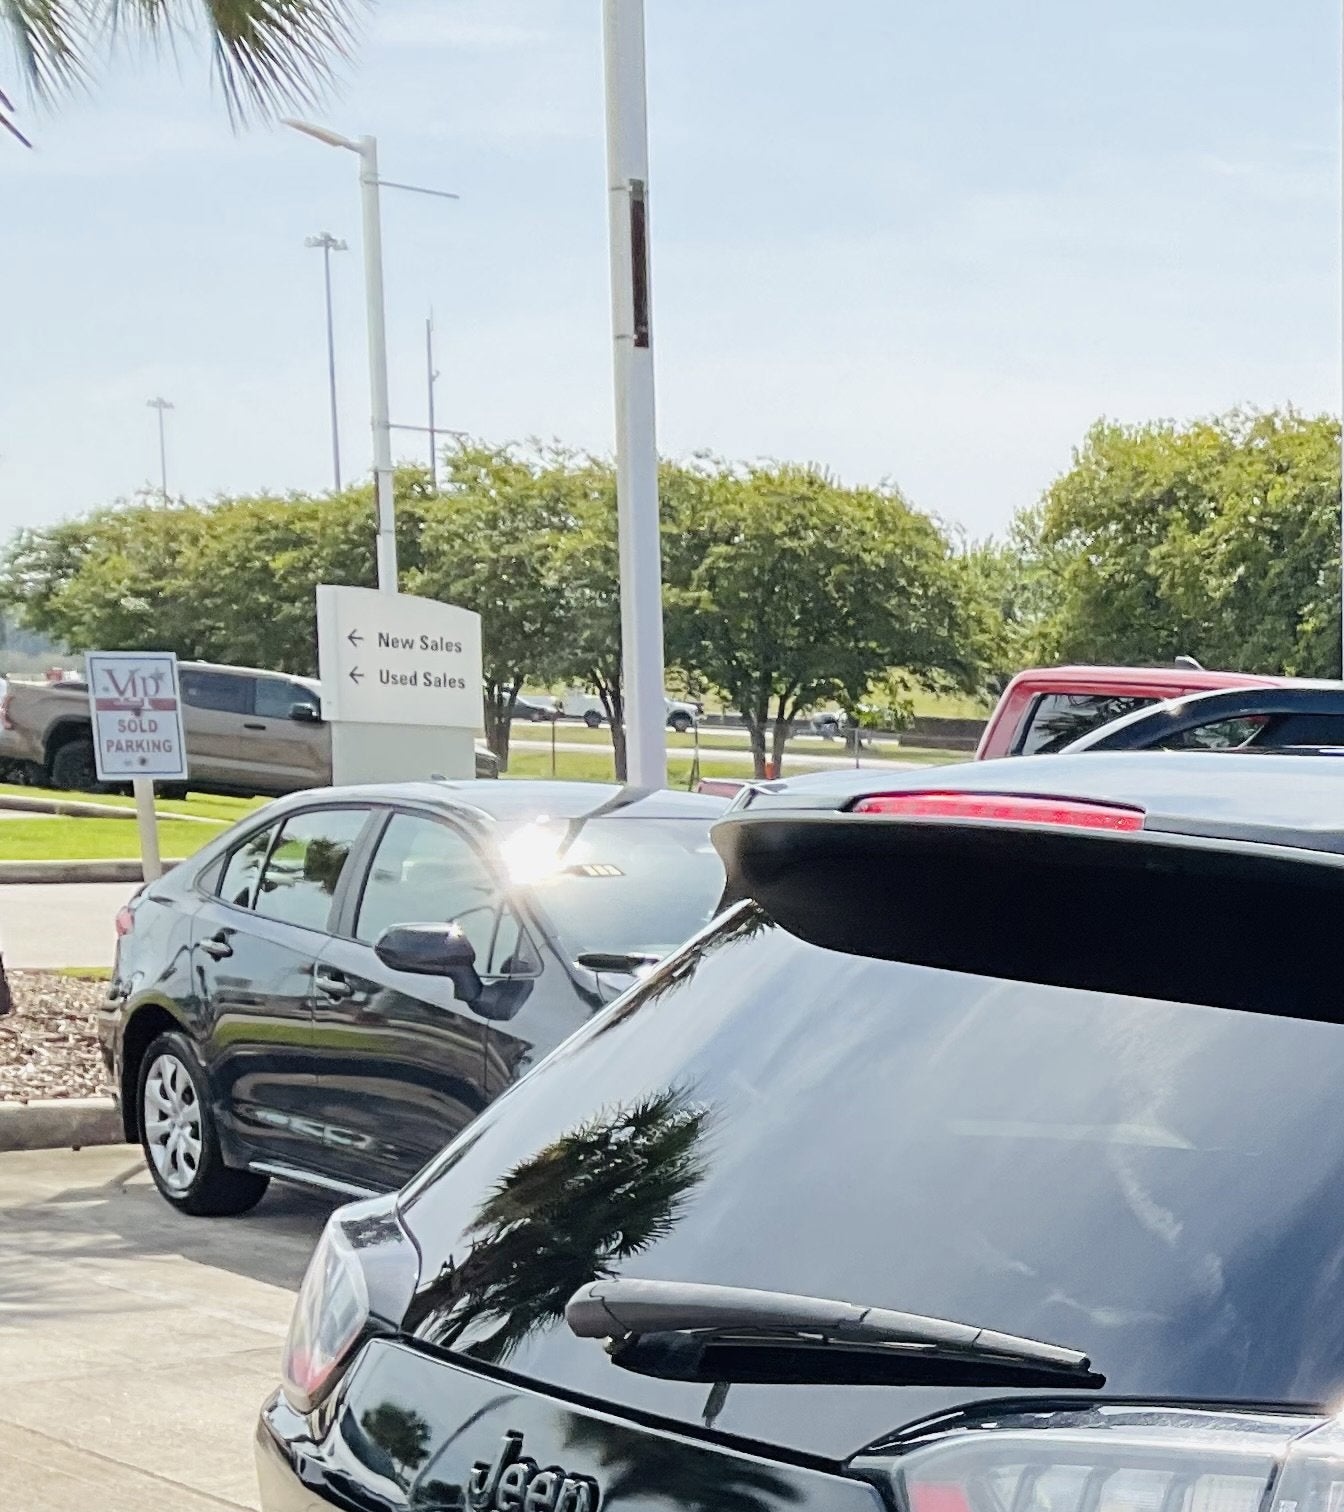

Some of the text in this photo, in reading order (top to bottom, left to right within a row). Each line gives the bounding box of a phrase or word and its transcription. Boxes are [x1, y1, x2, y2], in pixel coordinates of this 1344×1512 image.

[378, 632, 462, 653] New Sales
[379, 669, 466, 689] Used Sales
[118, 719, 158, 733] SOLD
[106, 739, 172, 753] PARKING
